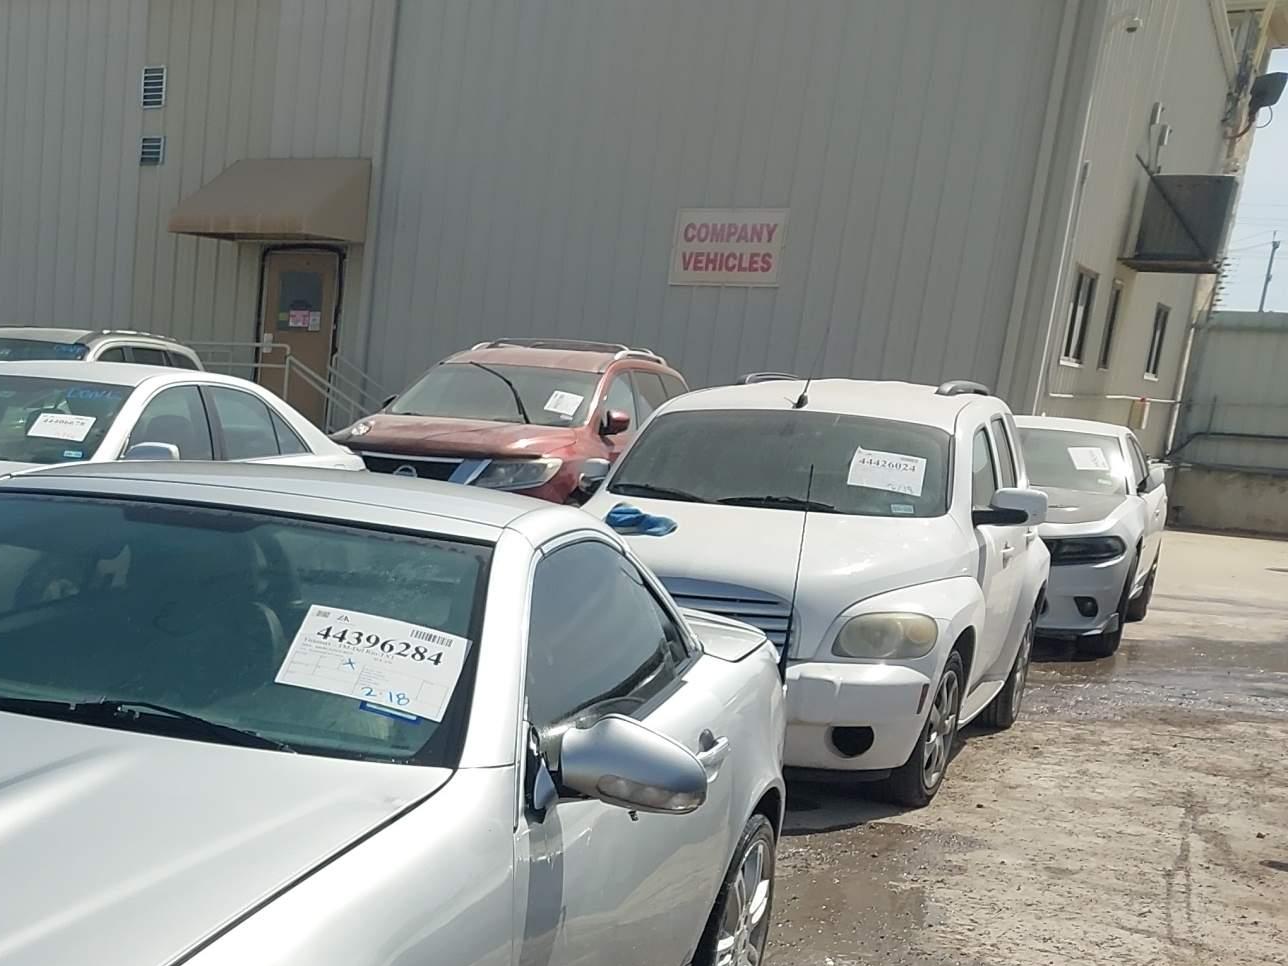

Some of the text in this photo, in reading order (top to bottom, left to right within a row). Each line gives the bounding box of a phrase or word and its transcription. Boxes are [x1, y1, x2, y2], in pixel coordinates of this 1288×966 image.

[684, 222, 778, 243] COMPANY
[682, 252, 773, 272] VEHICLES
[859, 458, 916, 472] 44426024
[316, 625, 444, 666] 44396284
